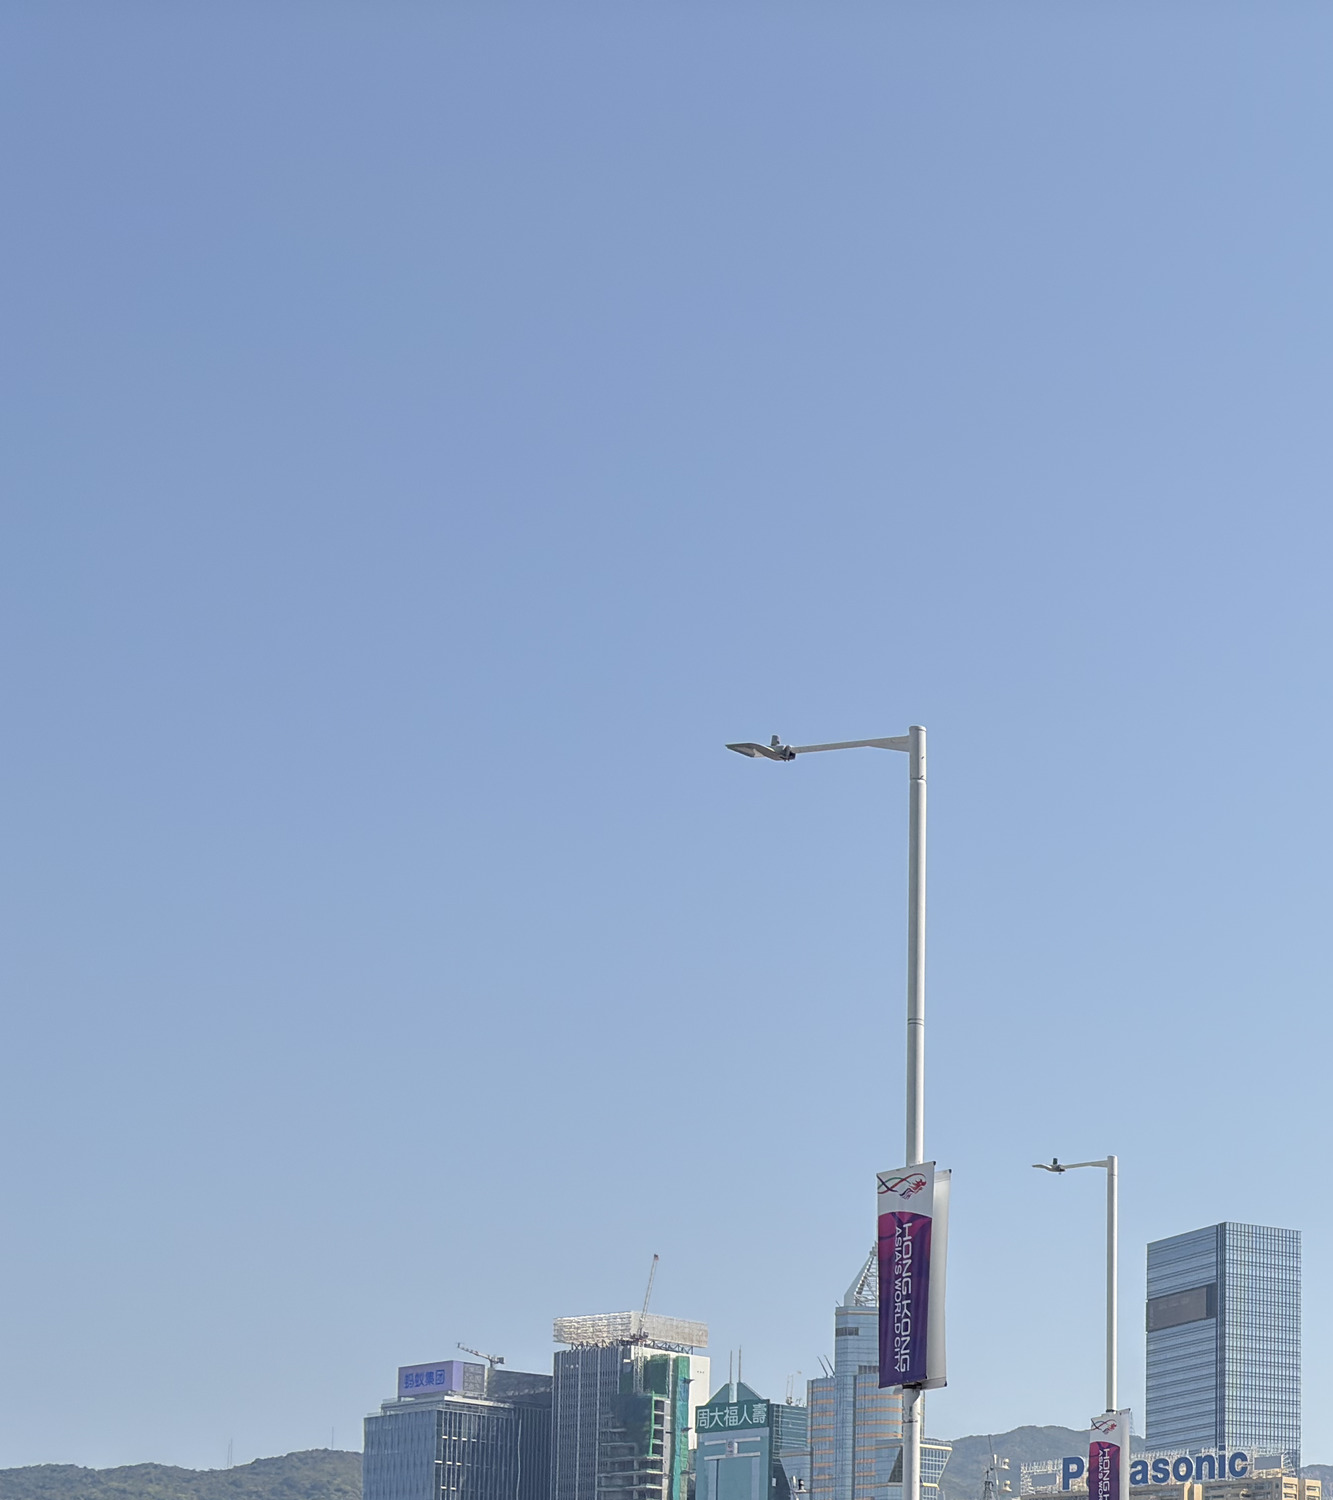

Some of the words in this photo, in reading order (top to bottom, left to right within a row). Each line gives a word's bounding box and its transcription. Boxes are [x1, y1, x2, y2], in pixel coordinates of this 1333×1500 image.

[894, 1226, 902, 1275] ASIA'S
[901, 1222, 913, 1295] HONG
[894, 1278, 902, 1335] WORLD
[900, 1299, 912, 1373] KONG
[404, 1369, 446, 1389] 蚂蚁集团
[696, 1403, 767, 1429] 周大福人壽
[1062, 1451, 1248, 1491] Pasonic
[1102, 1448, 1110, 1492] HONG
